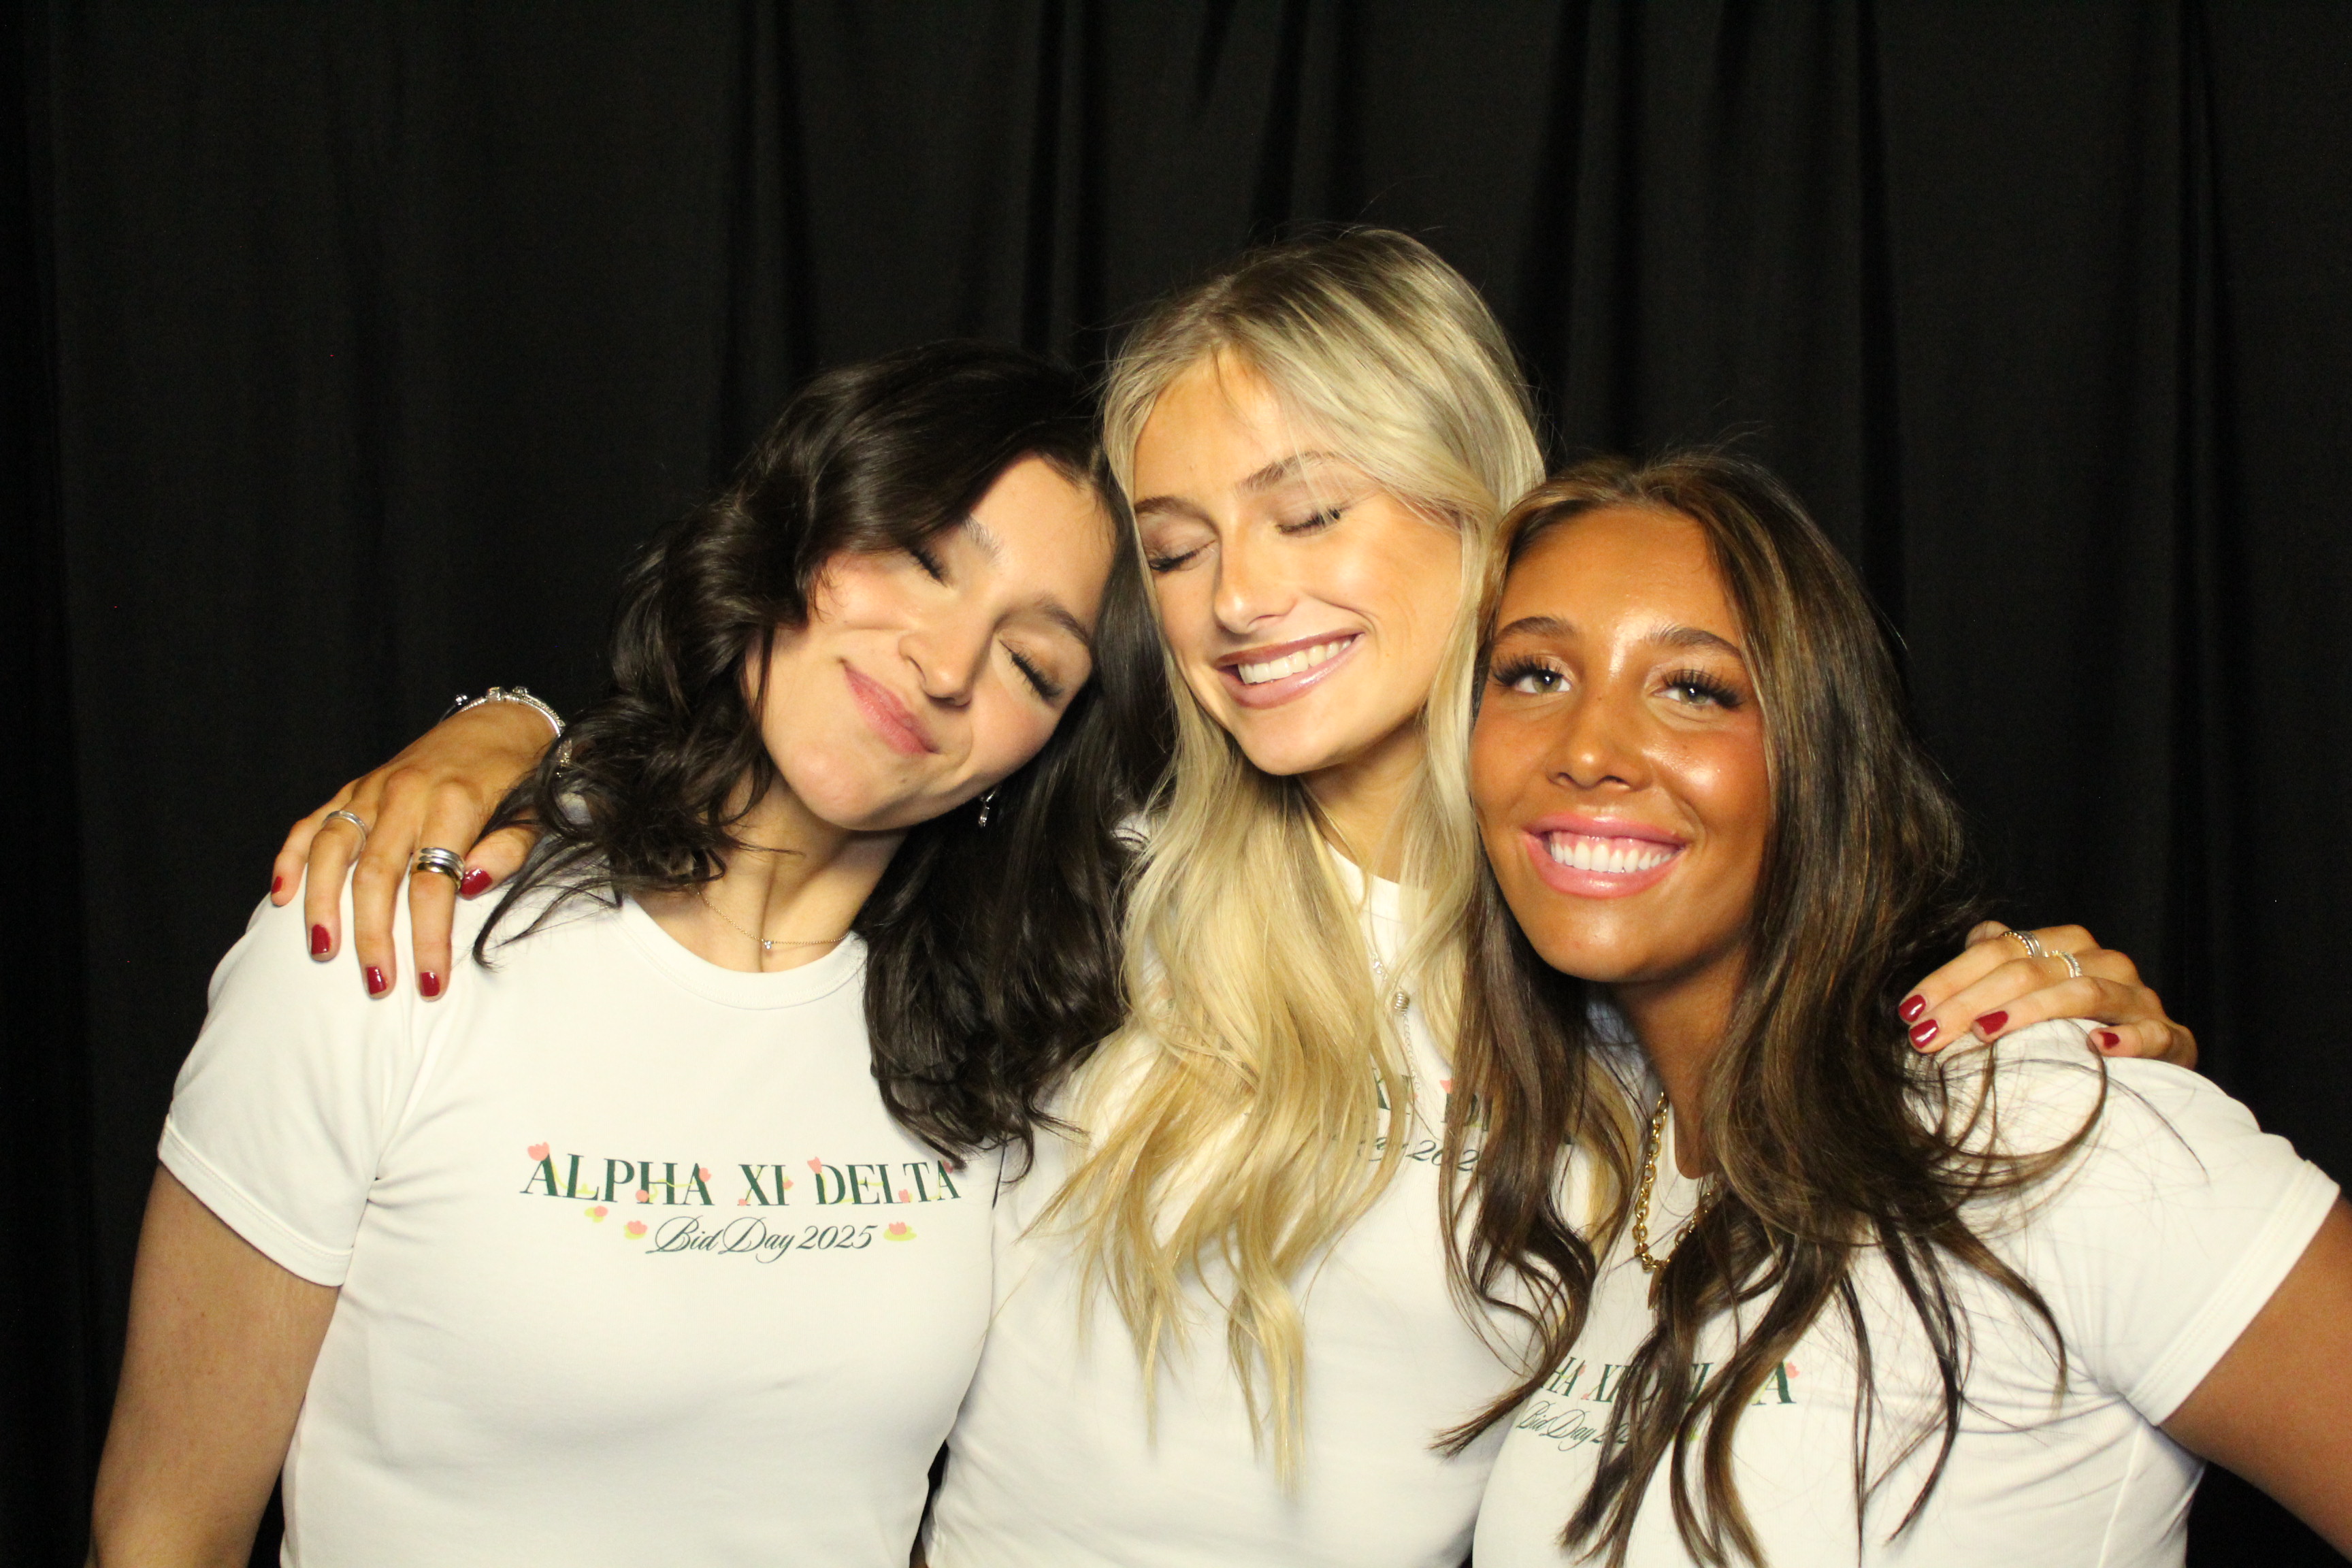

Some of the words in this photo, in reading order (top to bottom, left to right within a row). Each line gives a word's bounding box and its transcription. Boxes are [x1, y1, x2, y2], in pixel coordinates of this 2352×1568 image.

[519, 1153, 715, 1207] ALPHA
[738, 1163, 790, 1207] XI
[815, 1159, 962, 1206] DELTA
[645, 1215, 724, 1254] Bid
[717, 1217, 796, 1264] Day
[796, 1224, 879, 1250] 2025
[1516, 1400, 1558, 1431] Bid
[1539, 1409, 1597, 1452] Day
